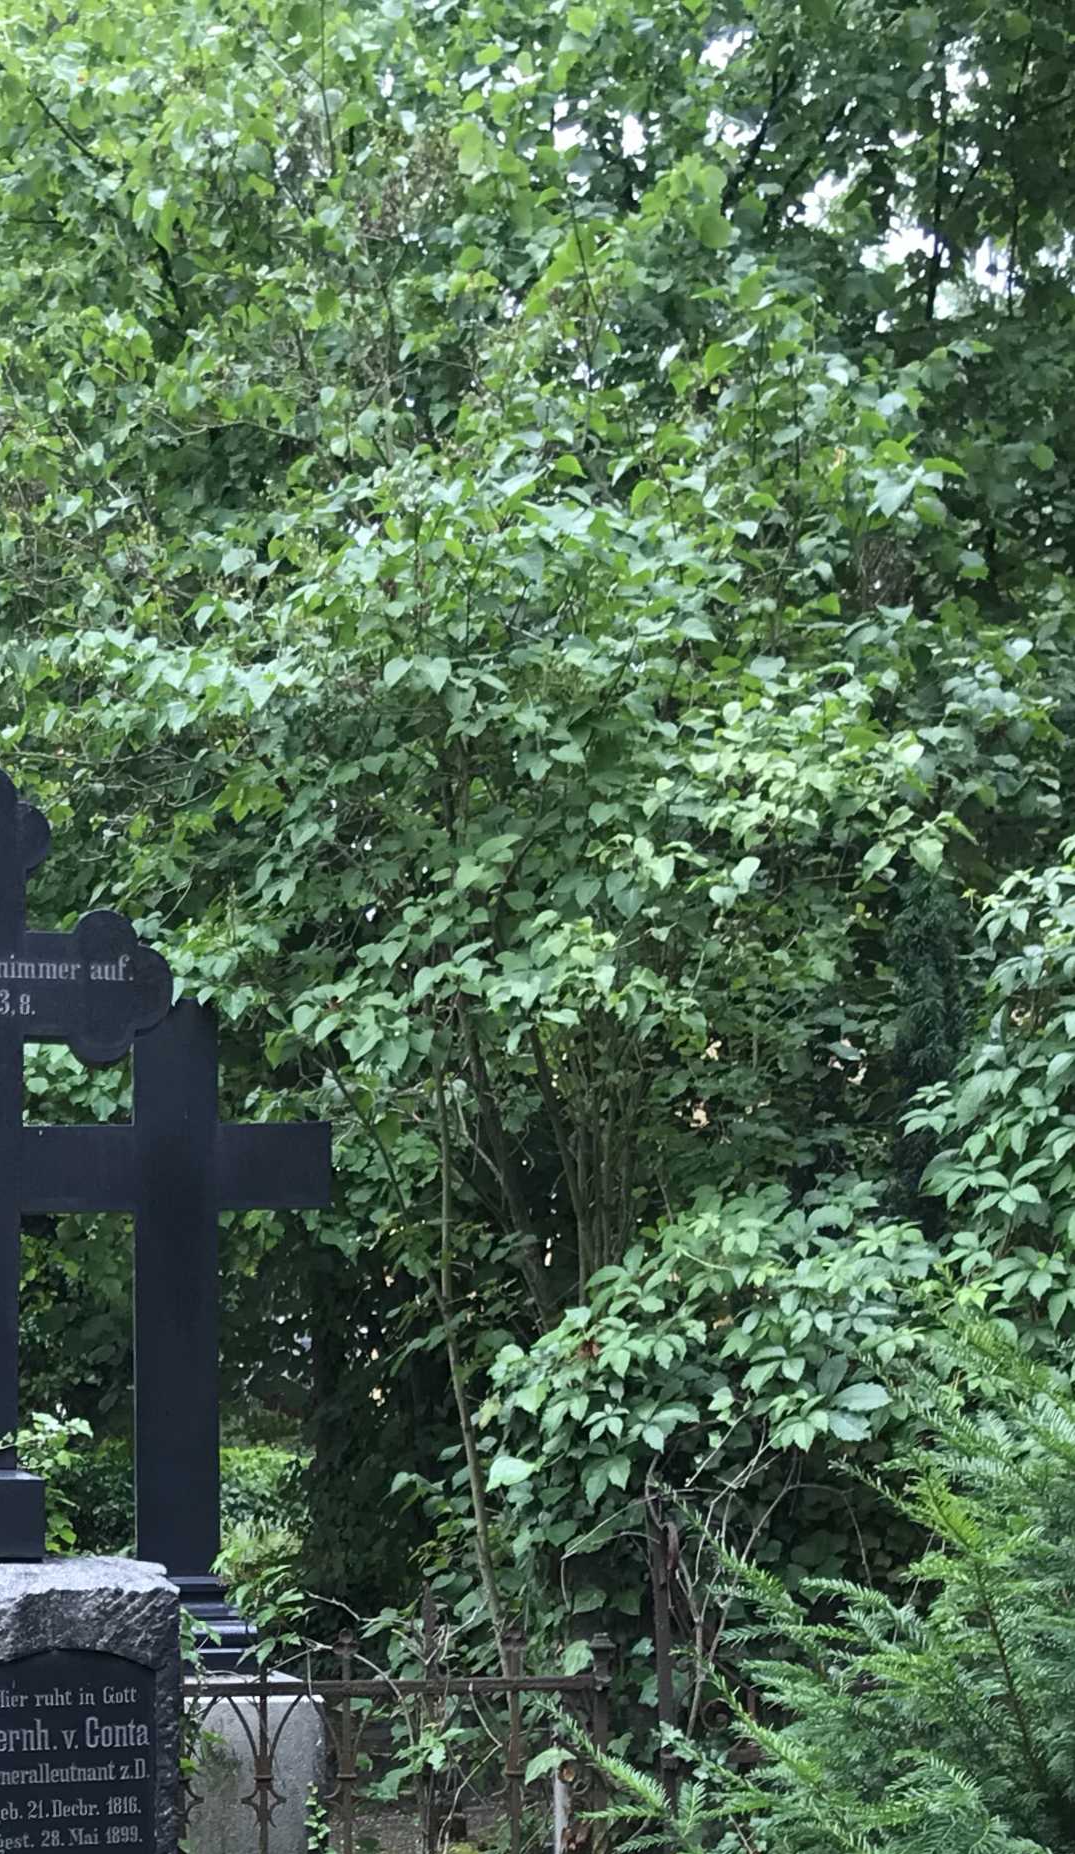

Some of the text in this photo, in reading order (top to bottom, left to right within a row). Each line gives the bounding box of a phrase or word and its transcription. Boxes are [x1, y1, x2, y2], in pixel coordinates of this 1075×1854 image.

[90, 956, 134, 981] auf.
[34, 1687, 72, 1707] ruht
[79, 1688, 95, 1705] in
[103, 1686, 137, 1704] Gott
[62, 1730, 79, 1749] v.
[85, 1717, 150, 1749] Conta
[106, 1796, 141, 1815] 1816.
[106, 1826, 142, 1844] 1899.
